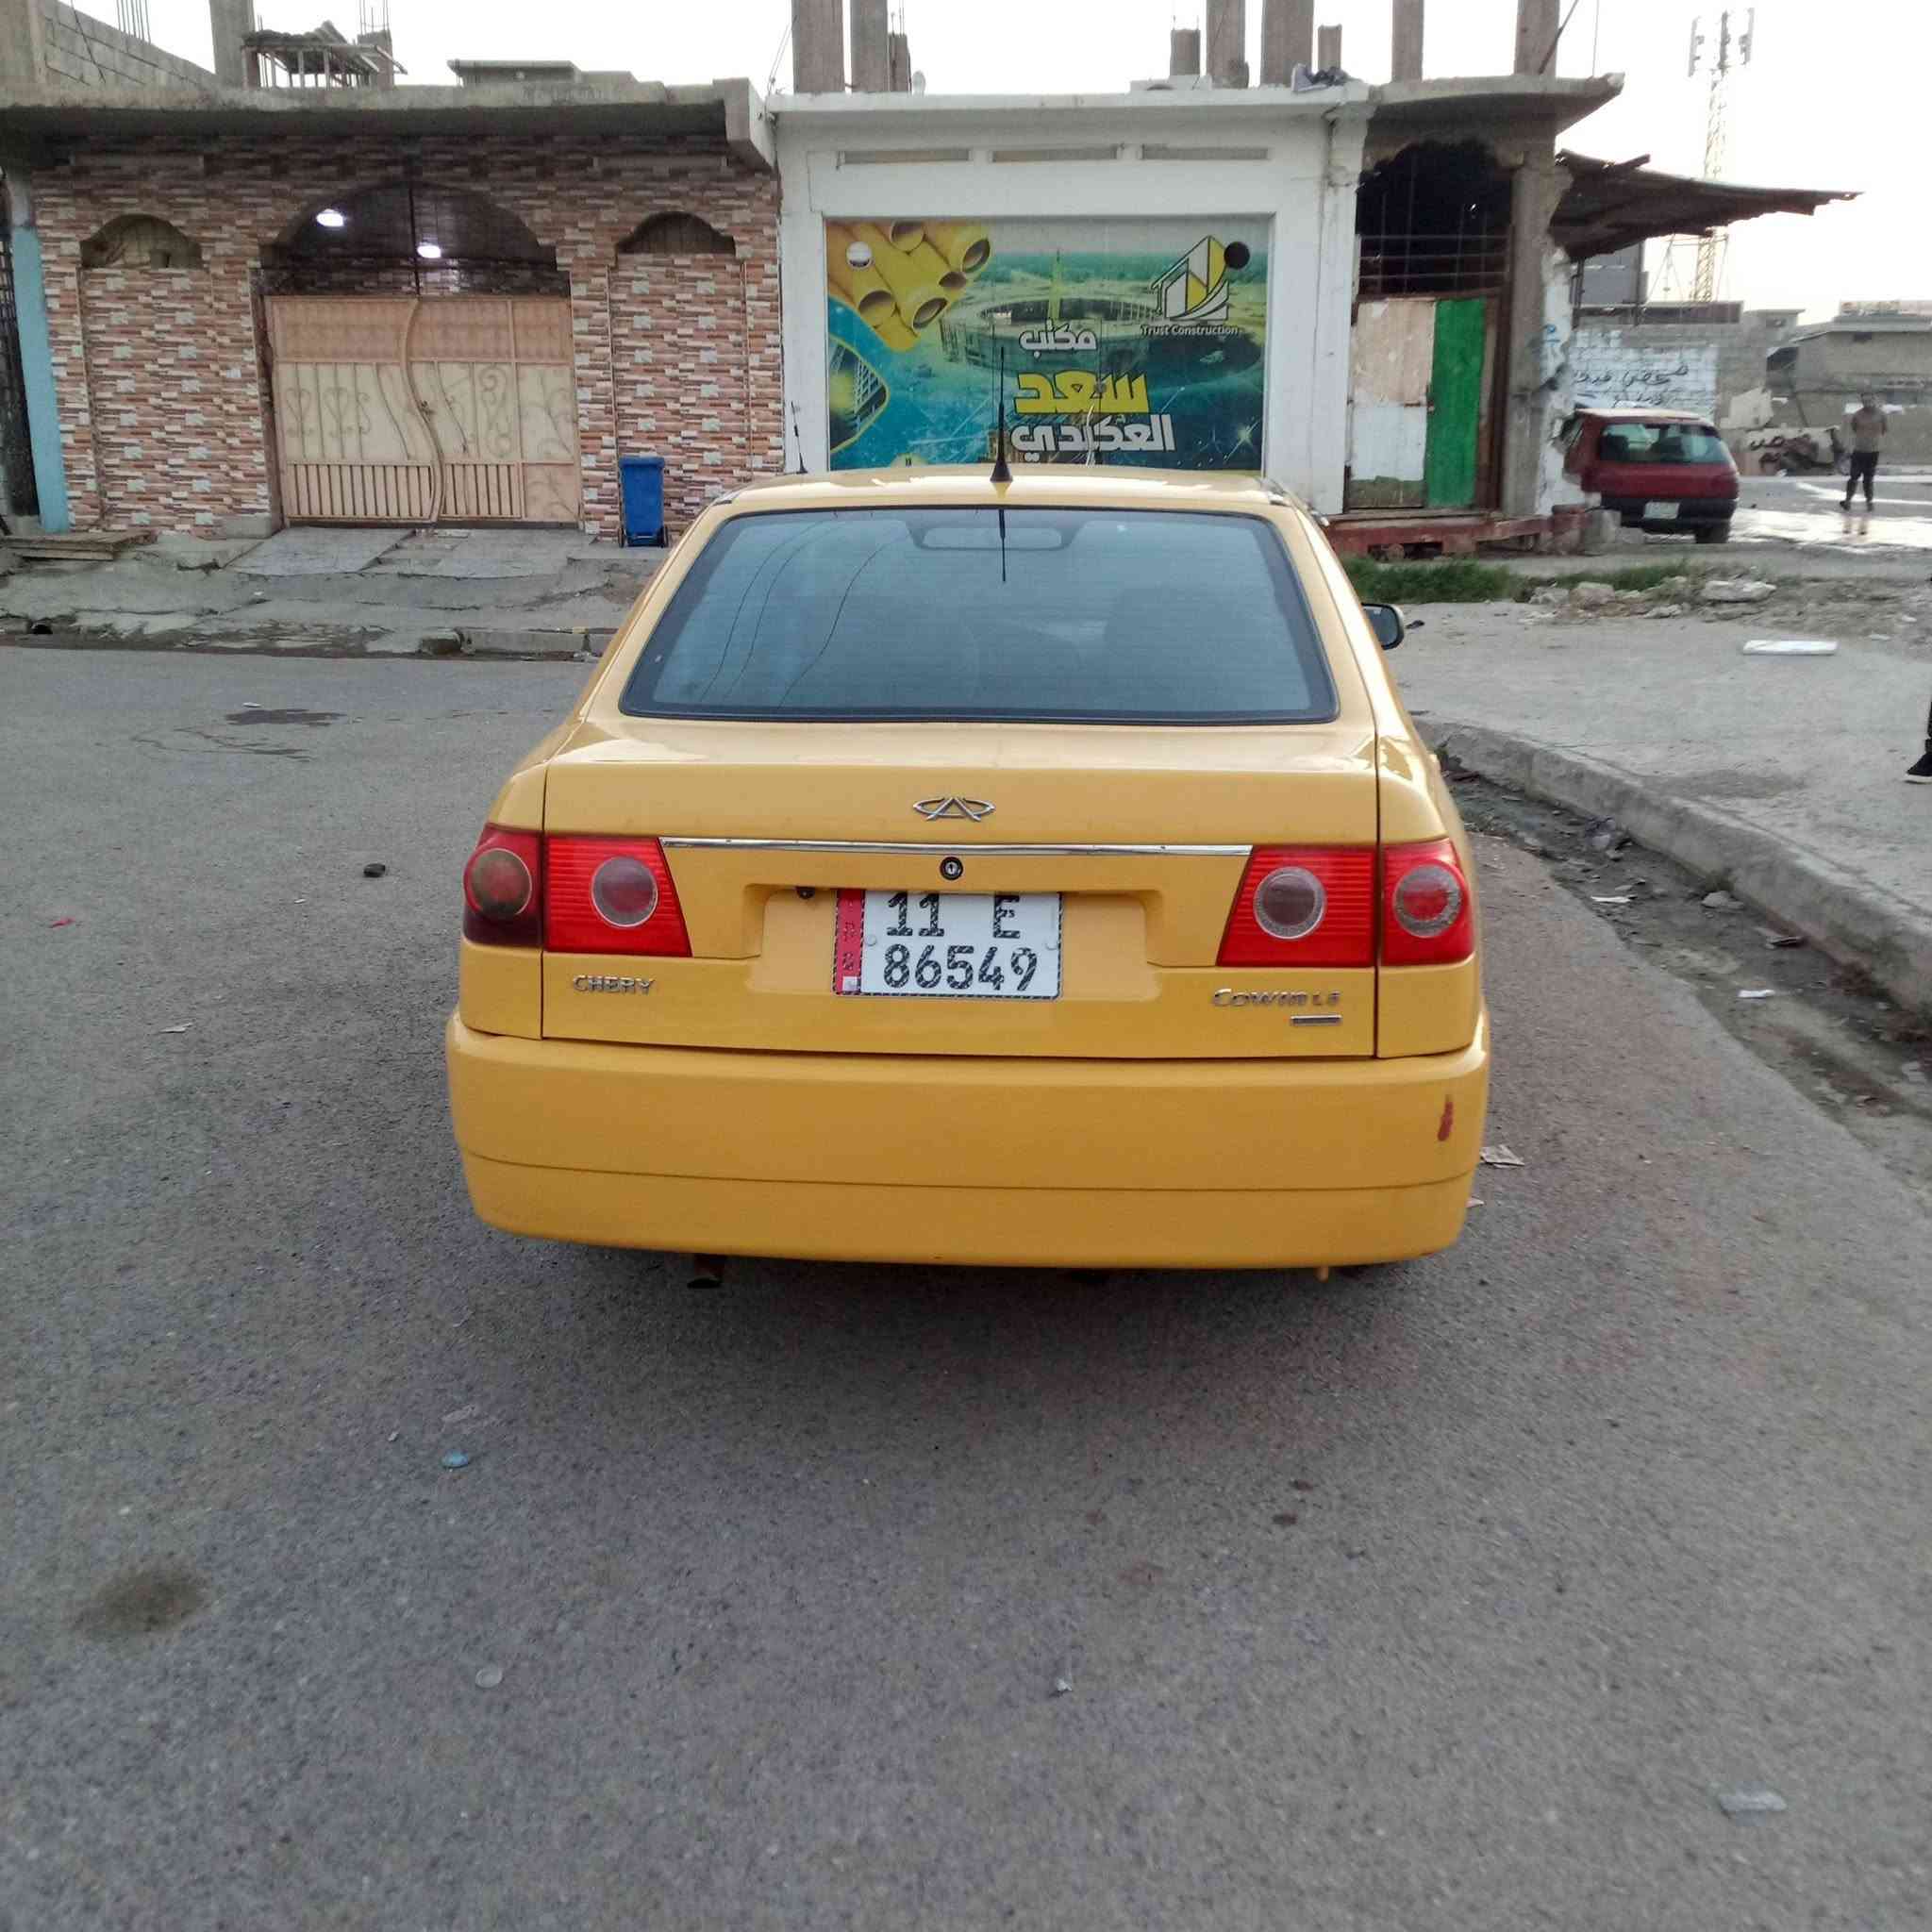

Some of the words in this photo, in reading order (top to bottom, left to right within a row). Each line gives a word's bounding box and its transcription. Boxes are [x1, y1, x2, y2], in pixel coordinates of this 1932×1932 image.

[1019, 320, 1097, 359] مكتب
[1140, 325, 1171, 336] Trust
[1171, 324, 1240, 336] Construction
[1014, 370, 1150, 413] سعد
[886, 892, 944, 937] 11
[573, 974, 656, 995] CHERY
[883, 943, 1038, 991] 86549
